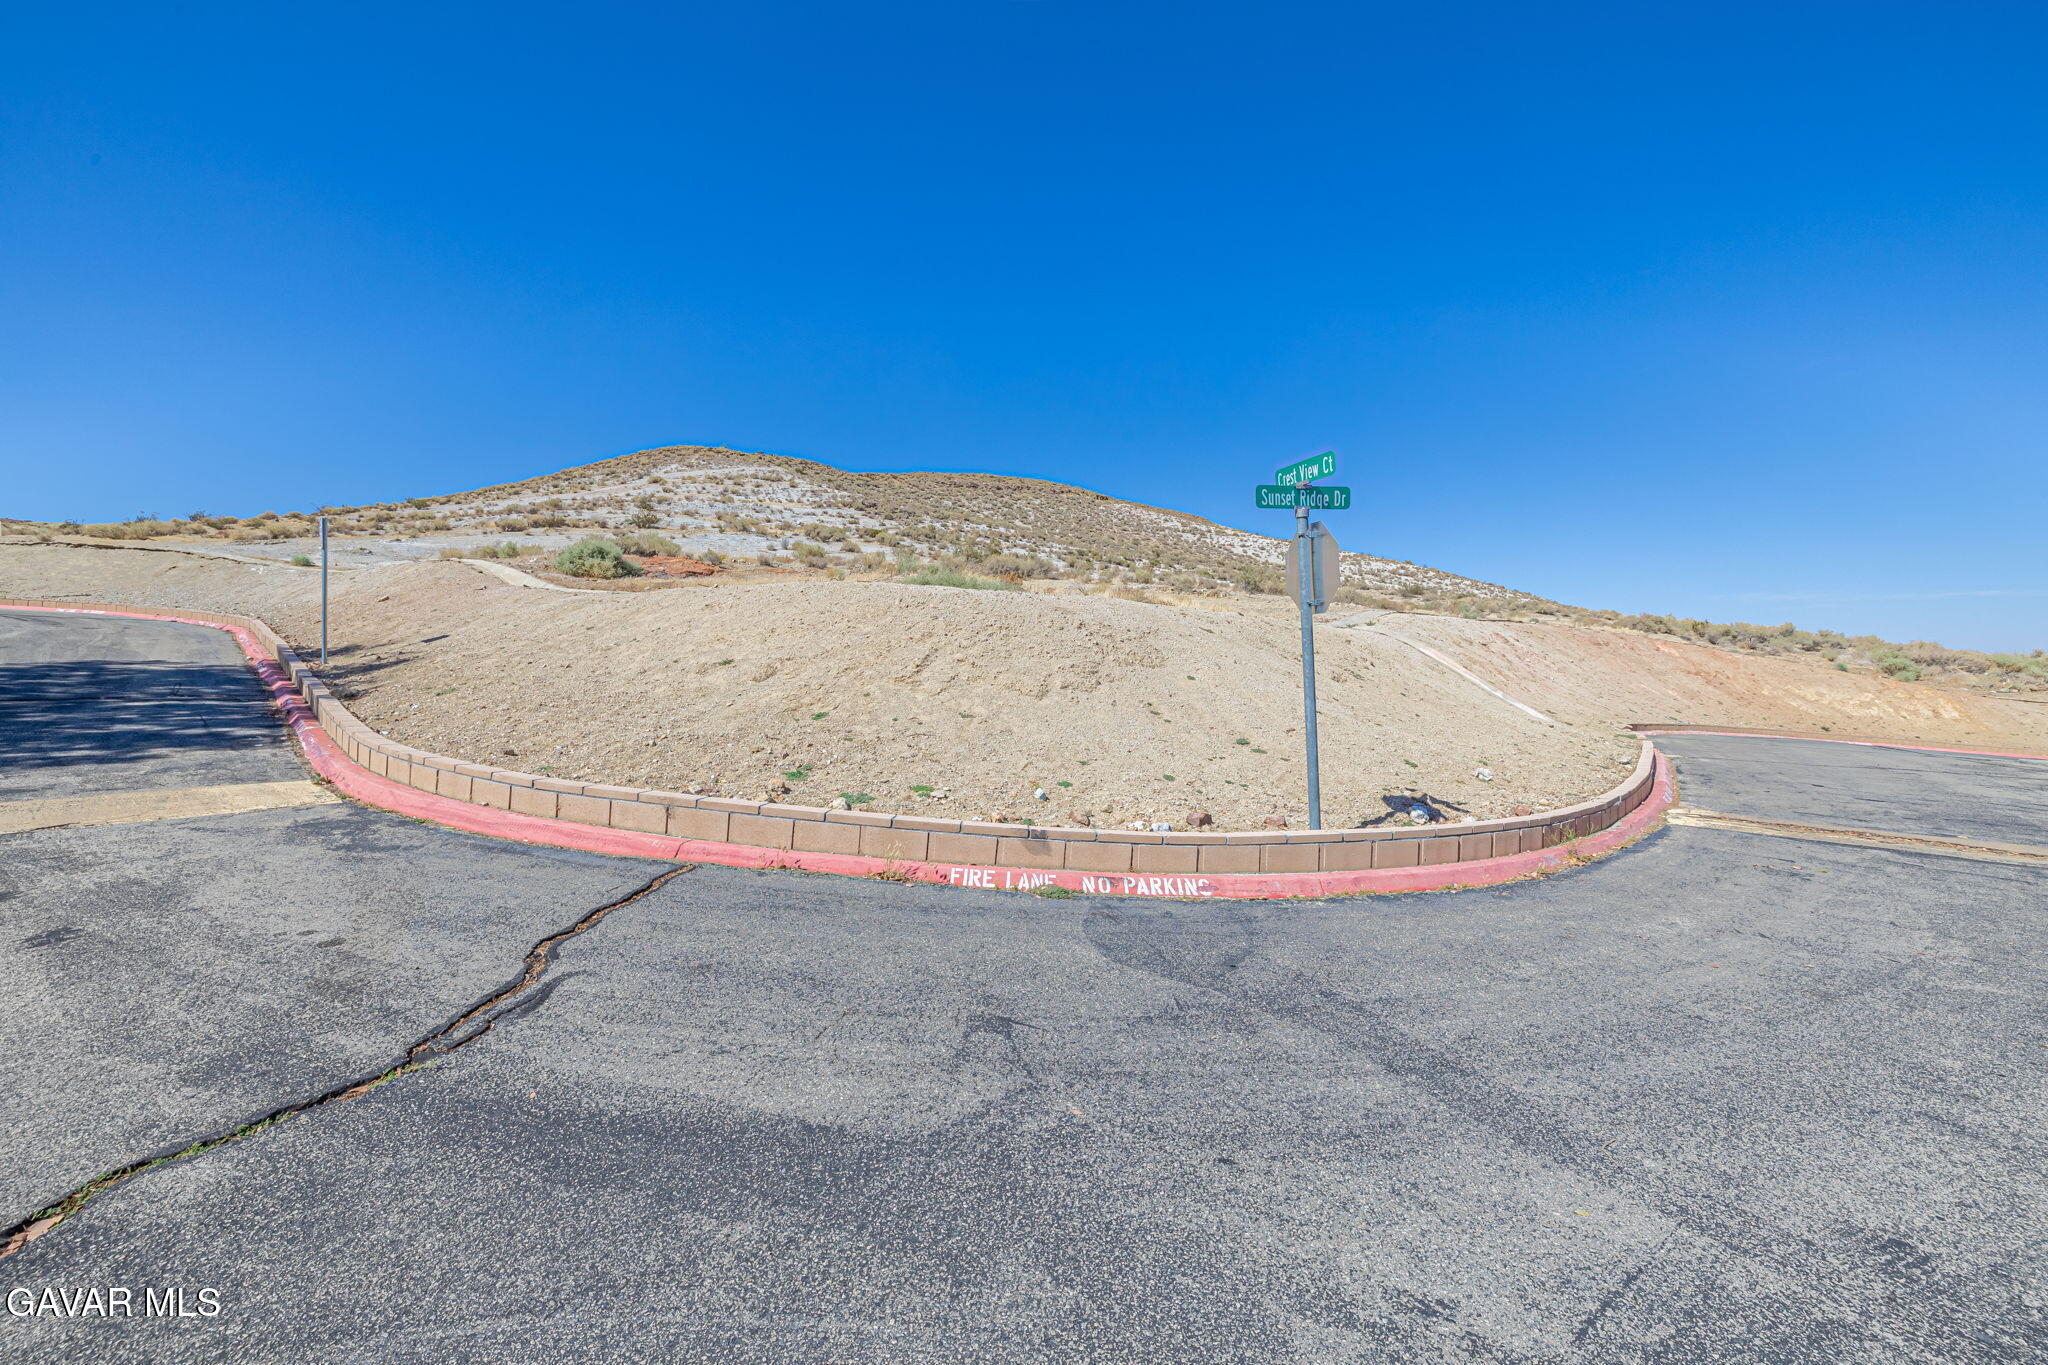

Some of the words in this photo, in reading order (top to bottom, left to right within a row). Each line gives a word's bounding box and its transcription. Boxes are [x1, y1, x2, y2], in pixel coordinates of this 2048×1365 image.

[1278, 468, 1297, 486] Crest
[1299, 463, 1319, 481] View
[1322, 455, 1333, 474] Ct
[1261, 488, 1295, 506] Sunset
[1300, 490, 1329, 509] Ridge
[1334, 490, 1346, 507] Dr
[950, 867, 996, 888] FIRE
[1082, 876, 1111, 894] NO
